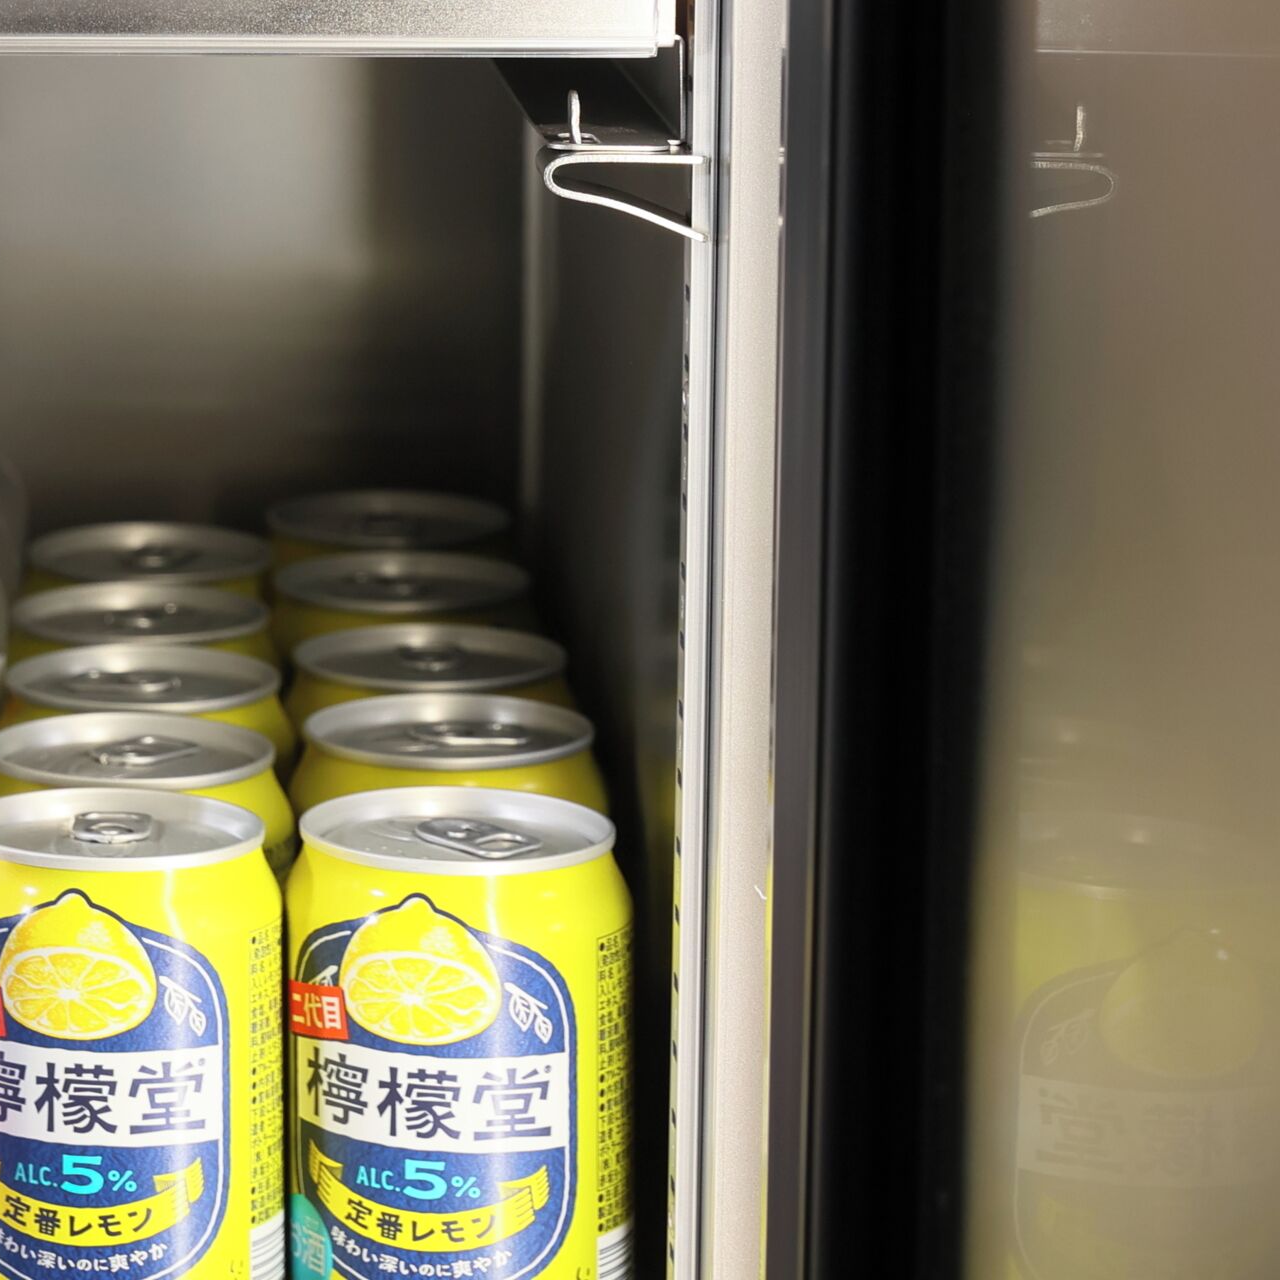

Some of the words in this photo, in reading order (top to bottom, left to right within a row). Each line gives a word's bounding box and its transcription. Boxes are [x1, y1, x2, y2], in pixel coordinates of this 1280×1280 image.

[292, 996, 343, 1030] 二代目
[307, 1047, 553, 1141] 檸檬堂
[2, 1194, 154, 1238] 定番レモン
[344, 1198, 496, 1243] 定番レモン
[330, 1224, 513, 1279] 味わい深いのに爽やか
